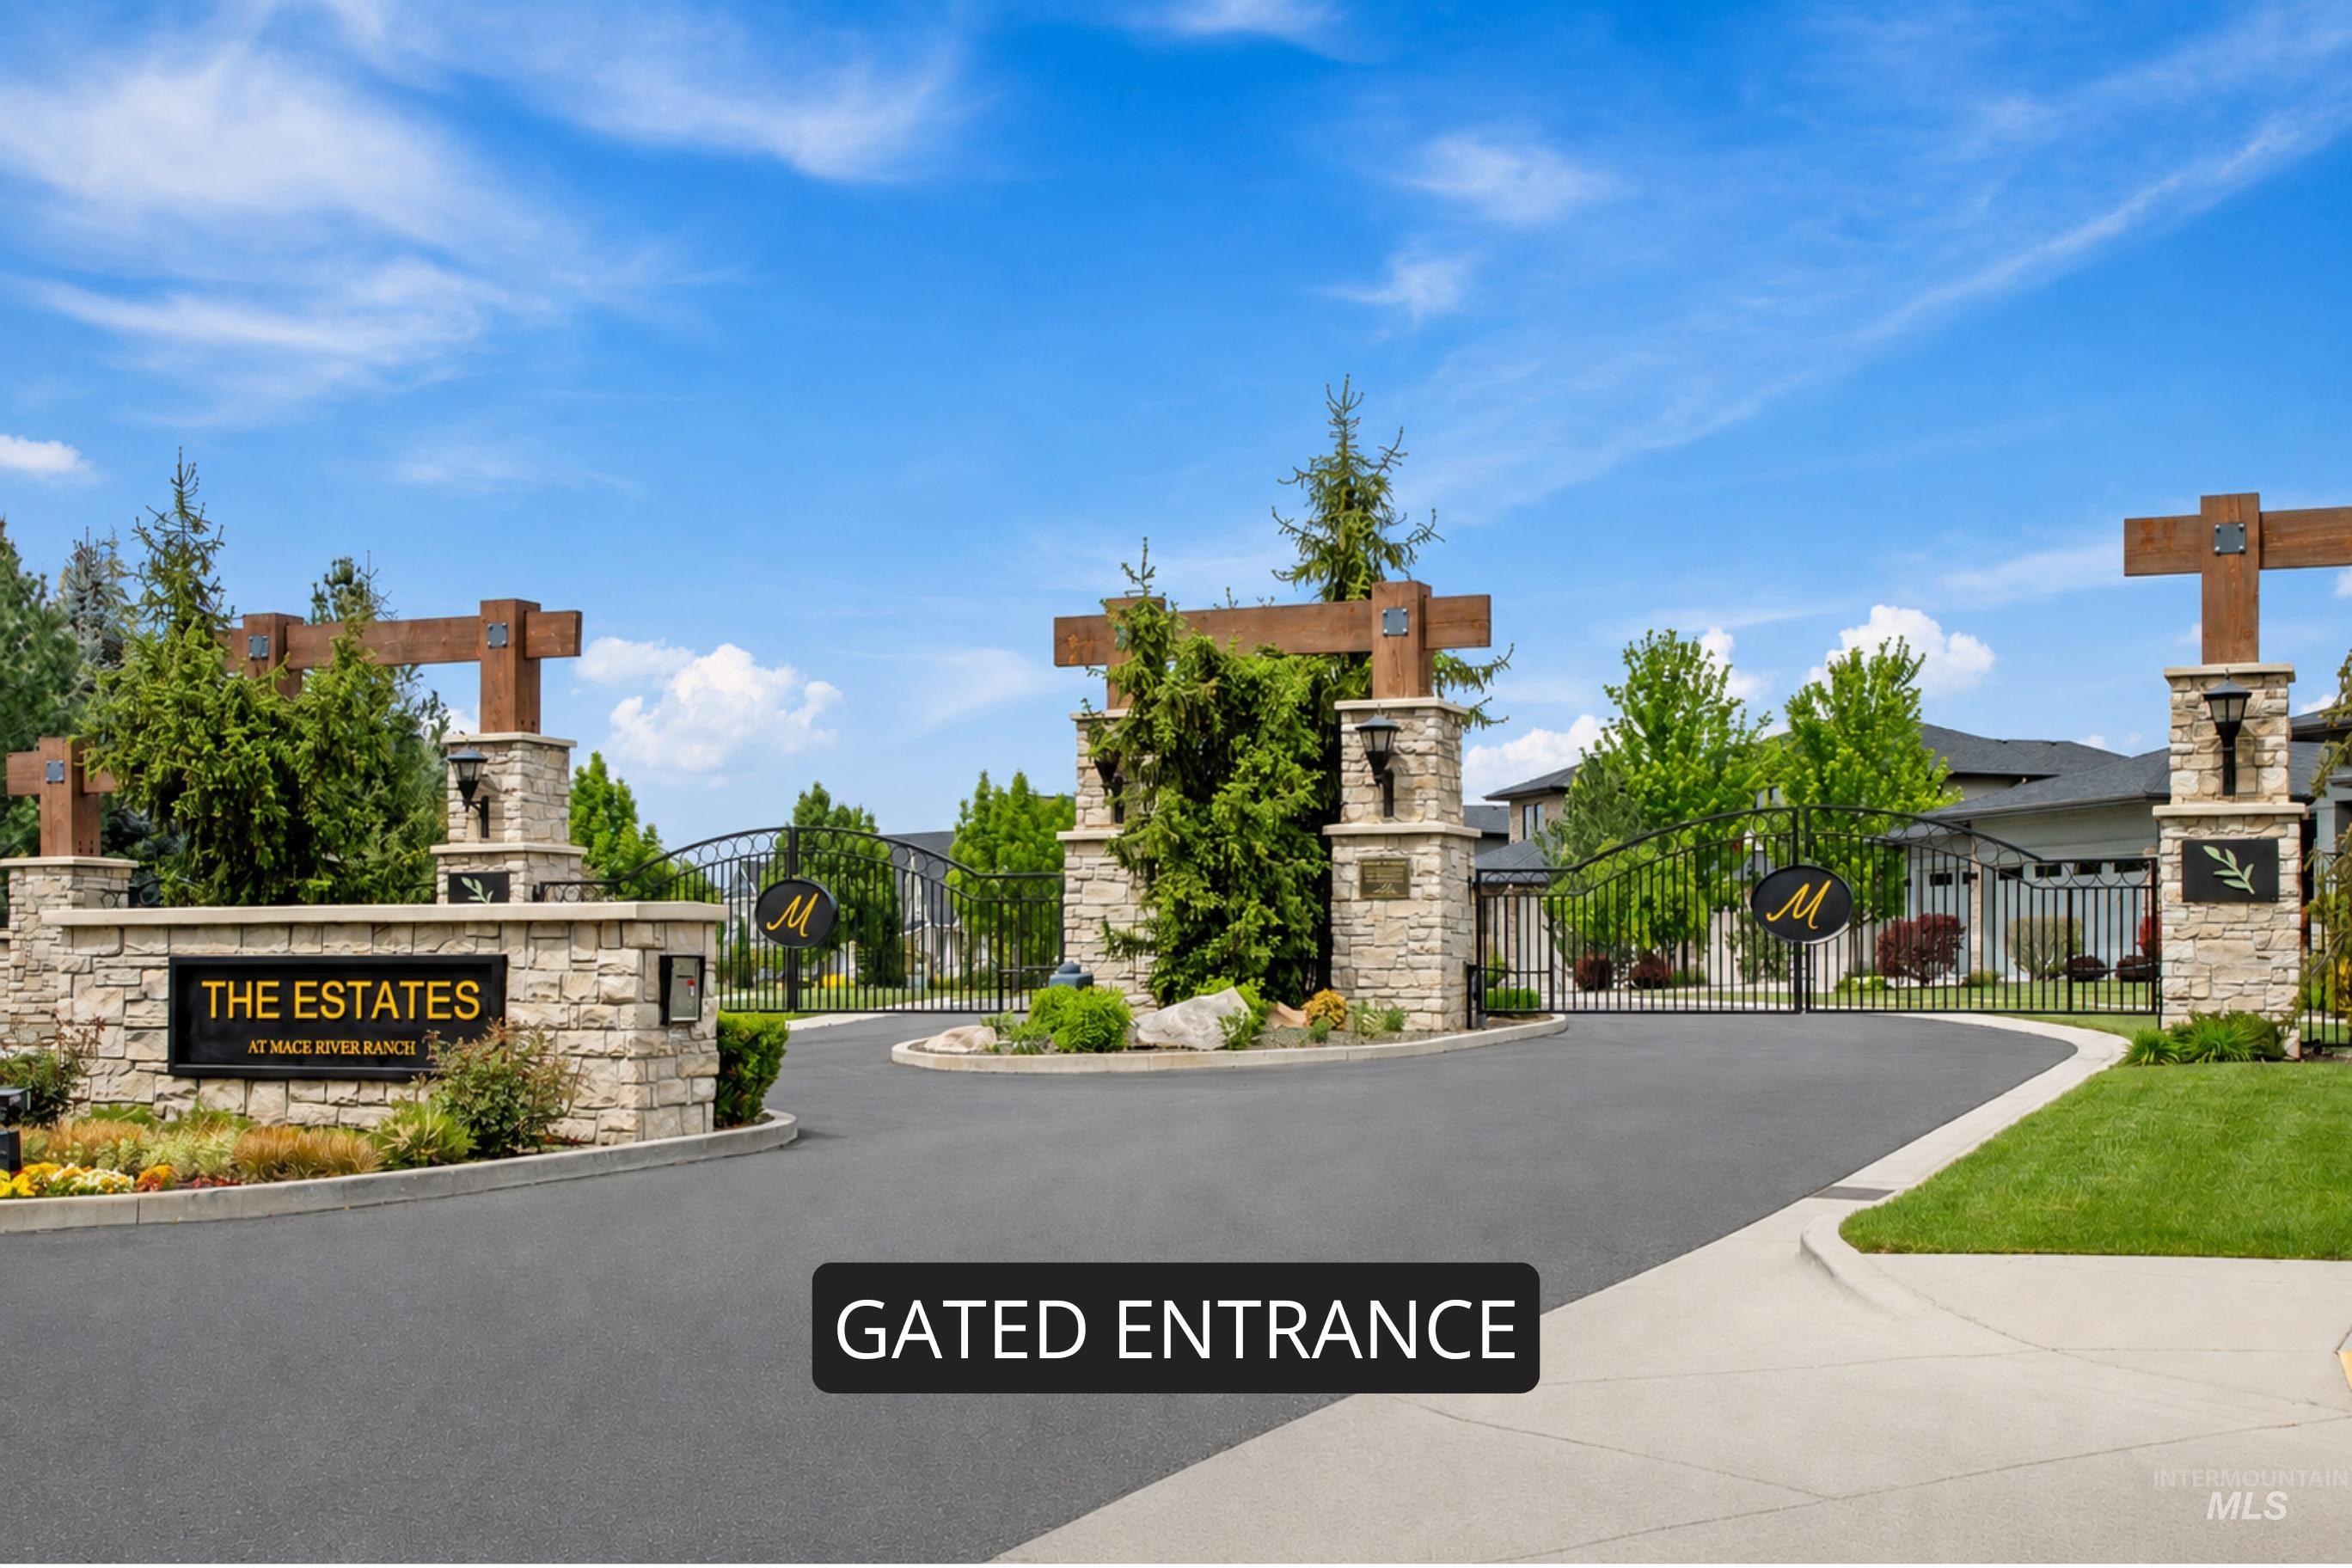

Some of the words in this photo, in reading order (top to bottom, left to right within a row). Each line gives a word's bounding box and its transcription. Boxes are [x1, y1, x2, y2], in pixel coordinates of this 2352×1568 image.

[766, 893, 819, 938] M
[1766, 879, 1832, 930] M
[201, 980, 280, 1020] THE
[294, 980, 481, 1020] ESTATES
[248, 1038, 267, 1054] AT
[270, 1039, 312, 1055] MACE
[315, 1039, 361, 1056] RIVER
[363, 1040, 416, 1056] RANCH
